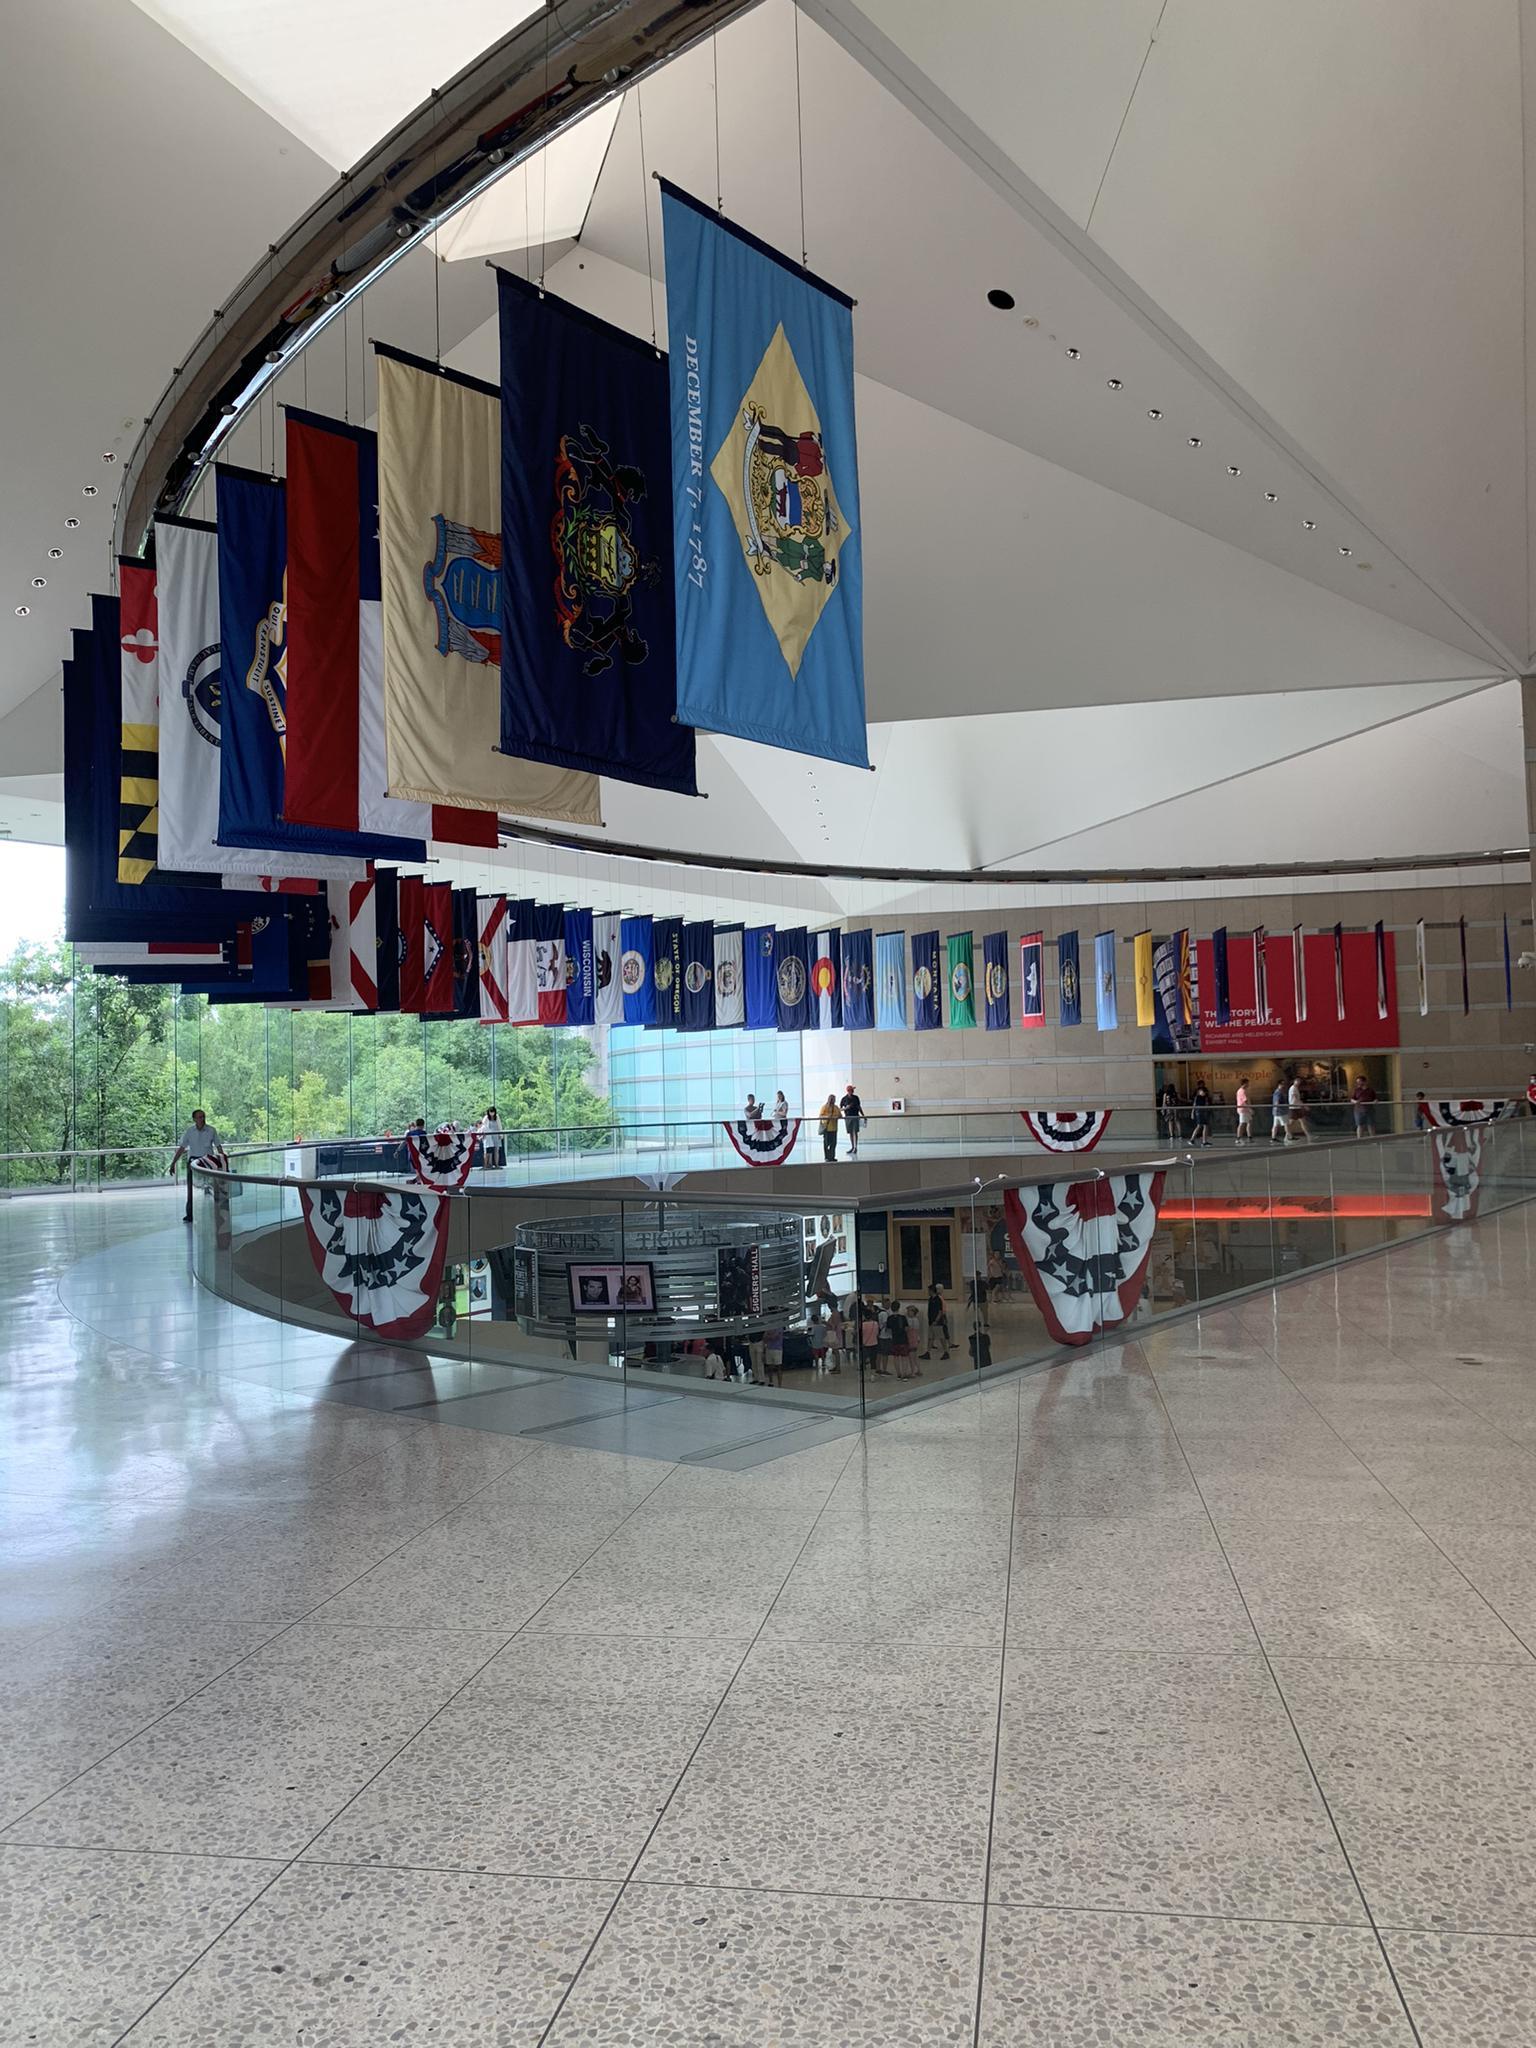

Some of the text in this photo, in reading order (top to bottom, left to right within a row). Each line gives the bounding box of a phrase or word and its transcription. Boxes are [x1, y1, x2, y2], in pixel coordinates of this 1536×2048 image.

[685, 333, 707, 588] DECEMBER 7, 1787
[252, 606, 285, 729] QUI TRANSTULIT SUSTINET
[583, 940, 592, 997] WISCONSIN
[1229, 1009, 1257, 1017] TORY
[1244, 1018, 1282, 1026] PEPLE
[1215, 1070, 1233, 1080] the
[536, 1232, 601, 1249] TICKETS
[636, 1230, 721, 1248] TICKETS
[751, 1248, 760, 1271] HALL
